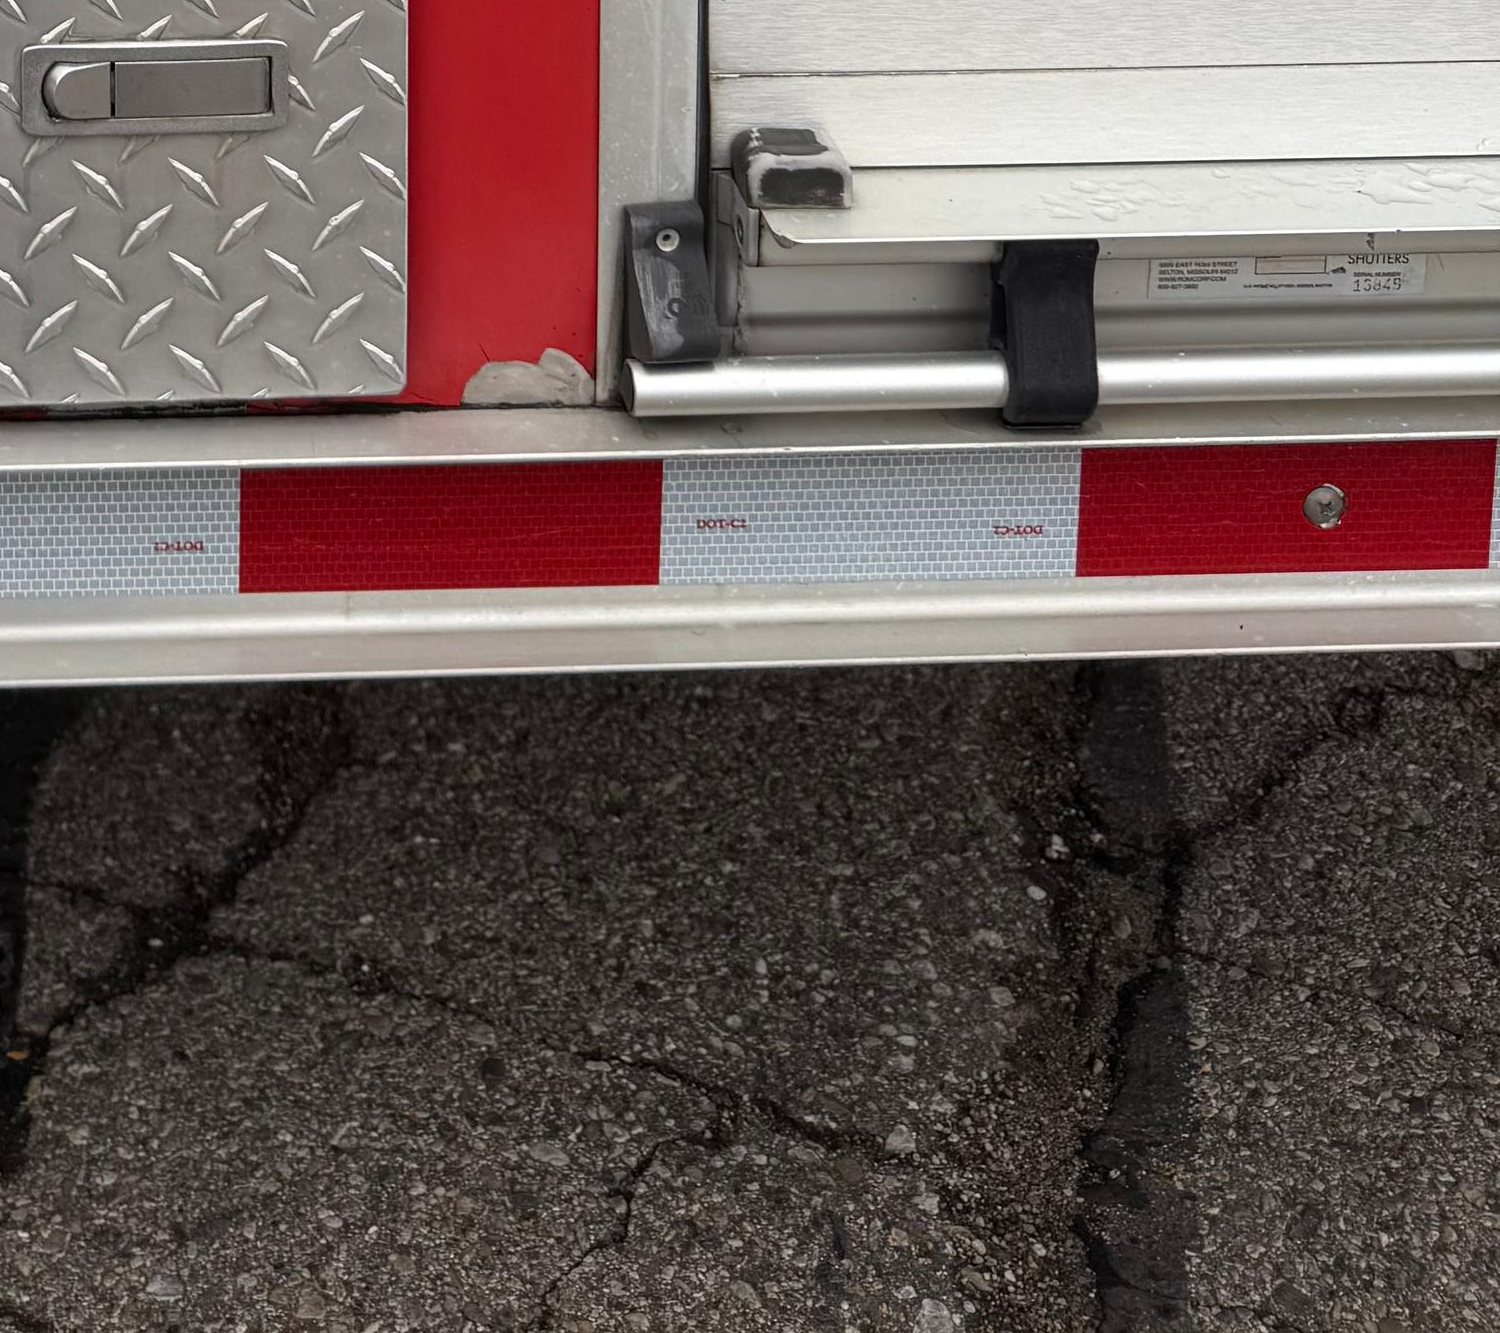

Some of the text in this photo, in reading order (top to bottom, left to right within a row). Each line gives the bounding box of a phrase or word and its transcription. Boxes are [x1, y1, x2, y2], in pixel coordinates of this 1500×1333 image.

[695, 518, 747, 530] DOT-C2
[993, 525, 1044, 536] DOT-C2
[153, 540, 204, 552] DOT-C2
